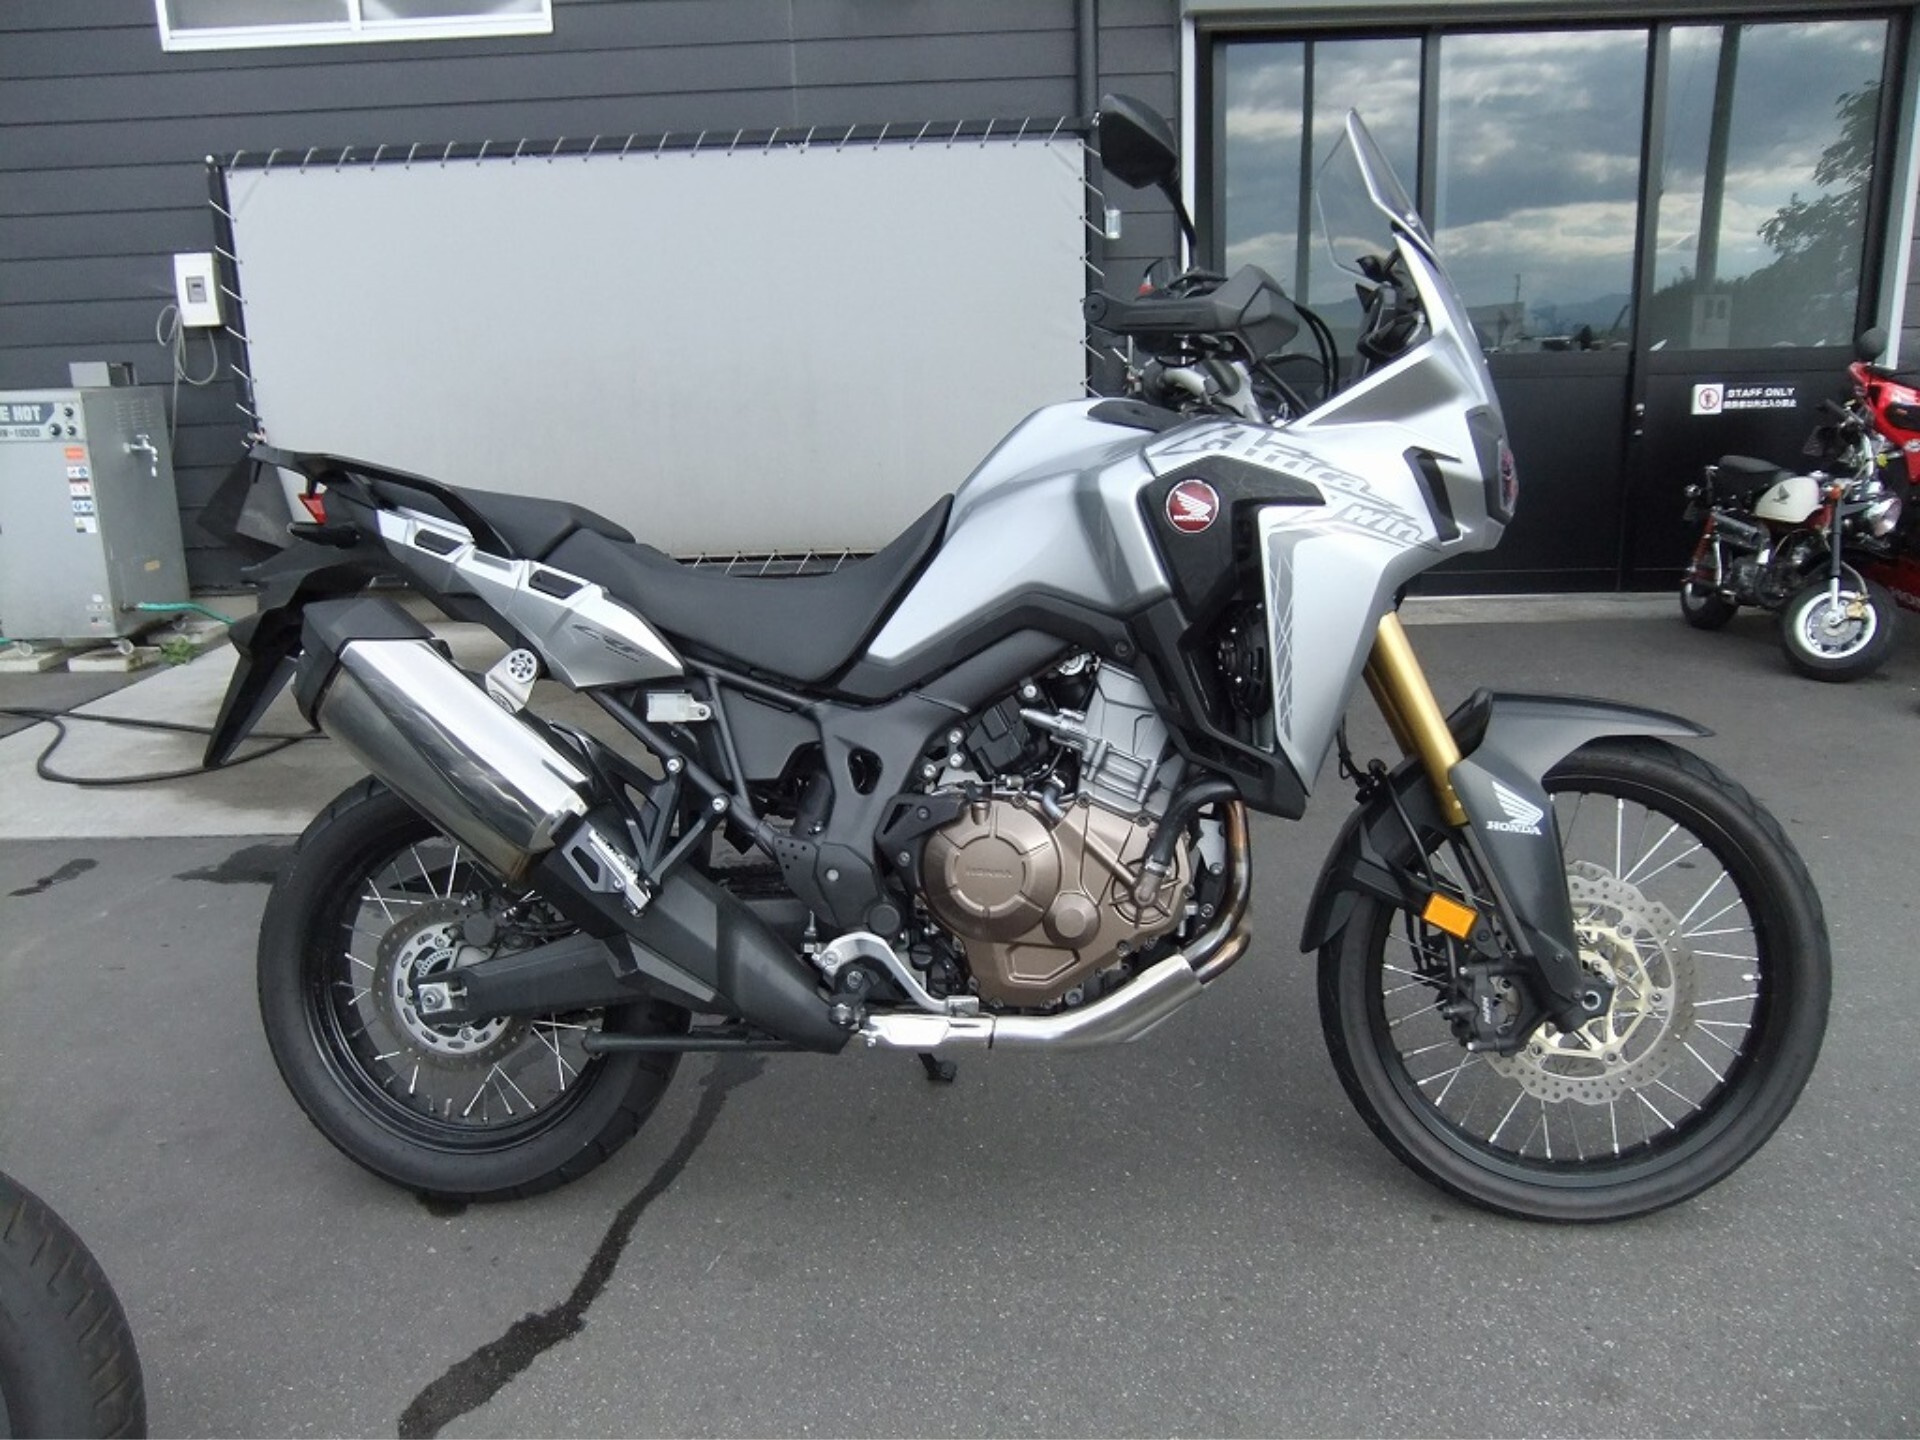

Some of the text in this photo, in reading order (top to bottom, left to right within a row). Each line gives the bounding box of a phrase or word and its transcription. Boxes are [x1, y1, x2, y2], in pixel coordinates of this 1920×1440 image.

[1727, 387, 1796, 398] STAFF ONLY
[12, 405, 41, 421] HOT
[1486, 820, 1543, 836] HONDA
